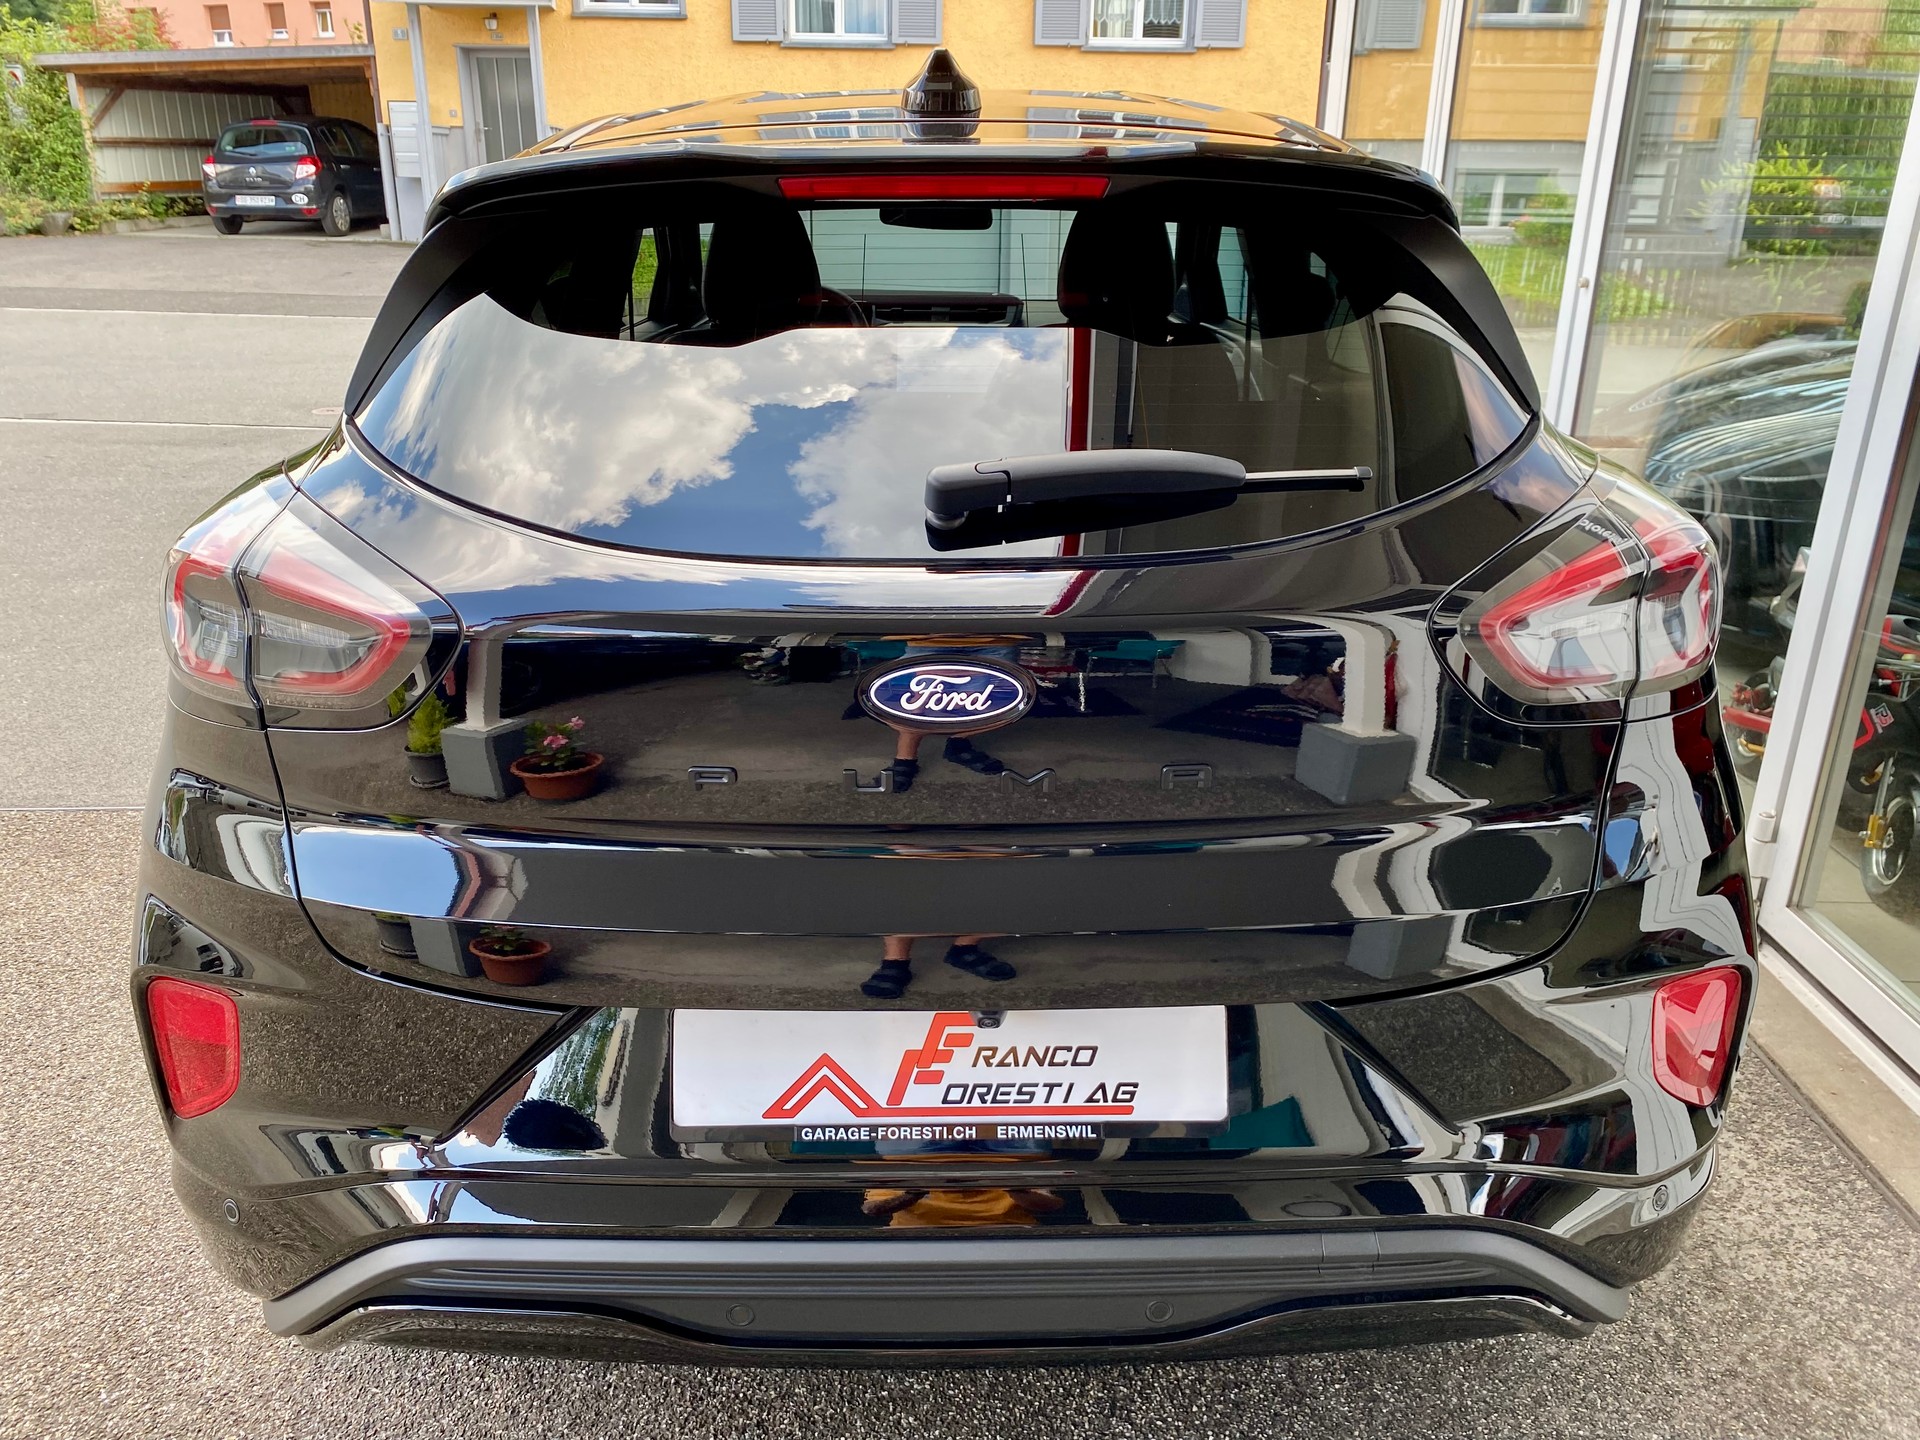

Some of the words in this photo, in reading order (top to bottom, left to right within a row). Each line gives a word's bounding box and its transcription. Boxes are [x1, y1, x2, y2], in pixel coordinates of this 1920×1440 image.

[294, 195, 305, 203] CH
[900, 674, 994, 711] Ford
[1083, 1082, 1139, 1104] AG
[801, 1126, 977, 1140] GARAGE-FORESTI.CH
[997, 1125, 1097, 1139] ERMENSWIL
